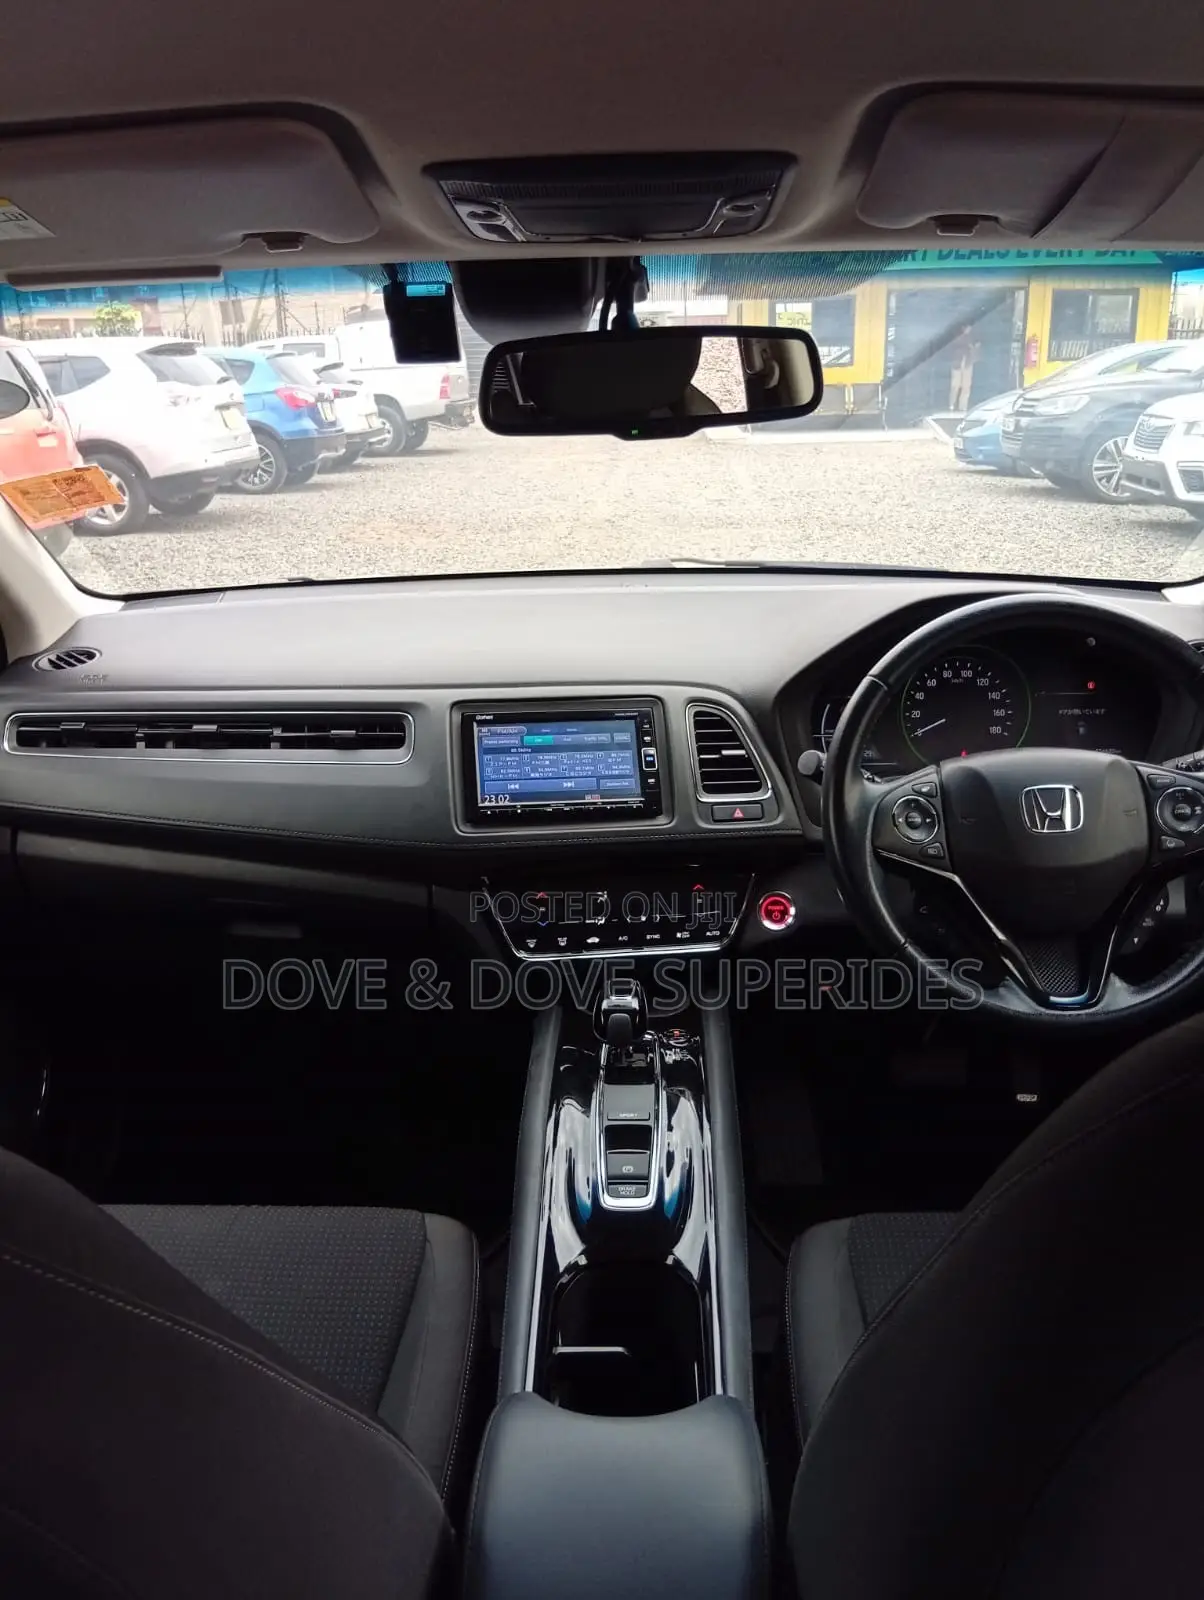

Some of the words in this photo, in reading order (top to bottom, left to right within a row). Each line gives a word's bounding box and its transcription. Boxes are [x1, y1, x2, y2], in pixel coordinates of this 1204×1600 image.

[942, 670, 953, 678] 80
[960, 670, 973, 678] 100
[926, 678, 937, 687] 60
[977, 678, 989, 686] 120
[914, 691, 925, 700] 40
[988, 691, 1001, 700] 140
[911, 710, 921, 718] 20
[993, 708, 1006, 717] 160
[989, 726, 1002, 735] 180
